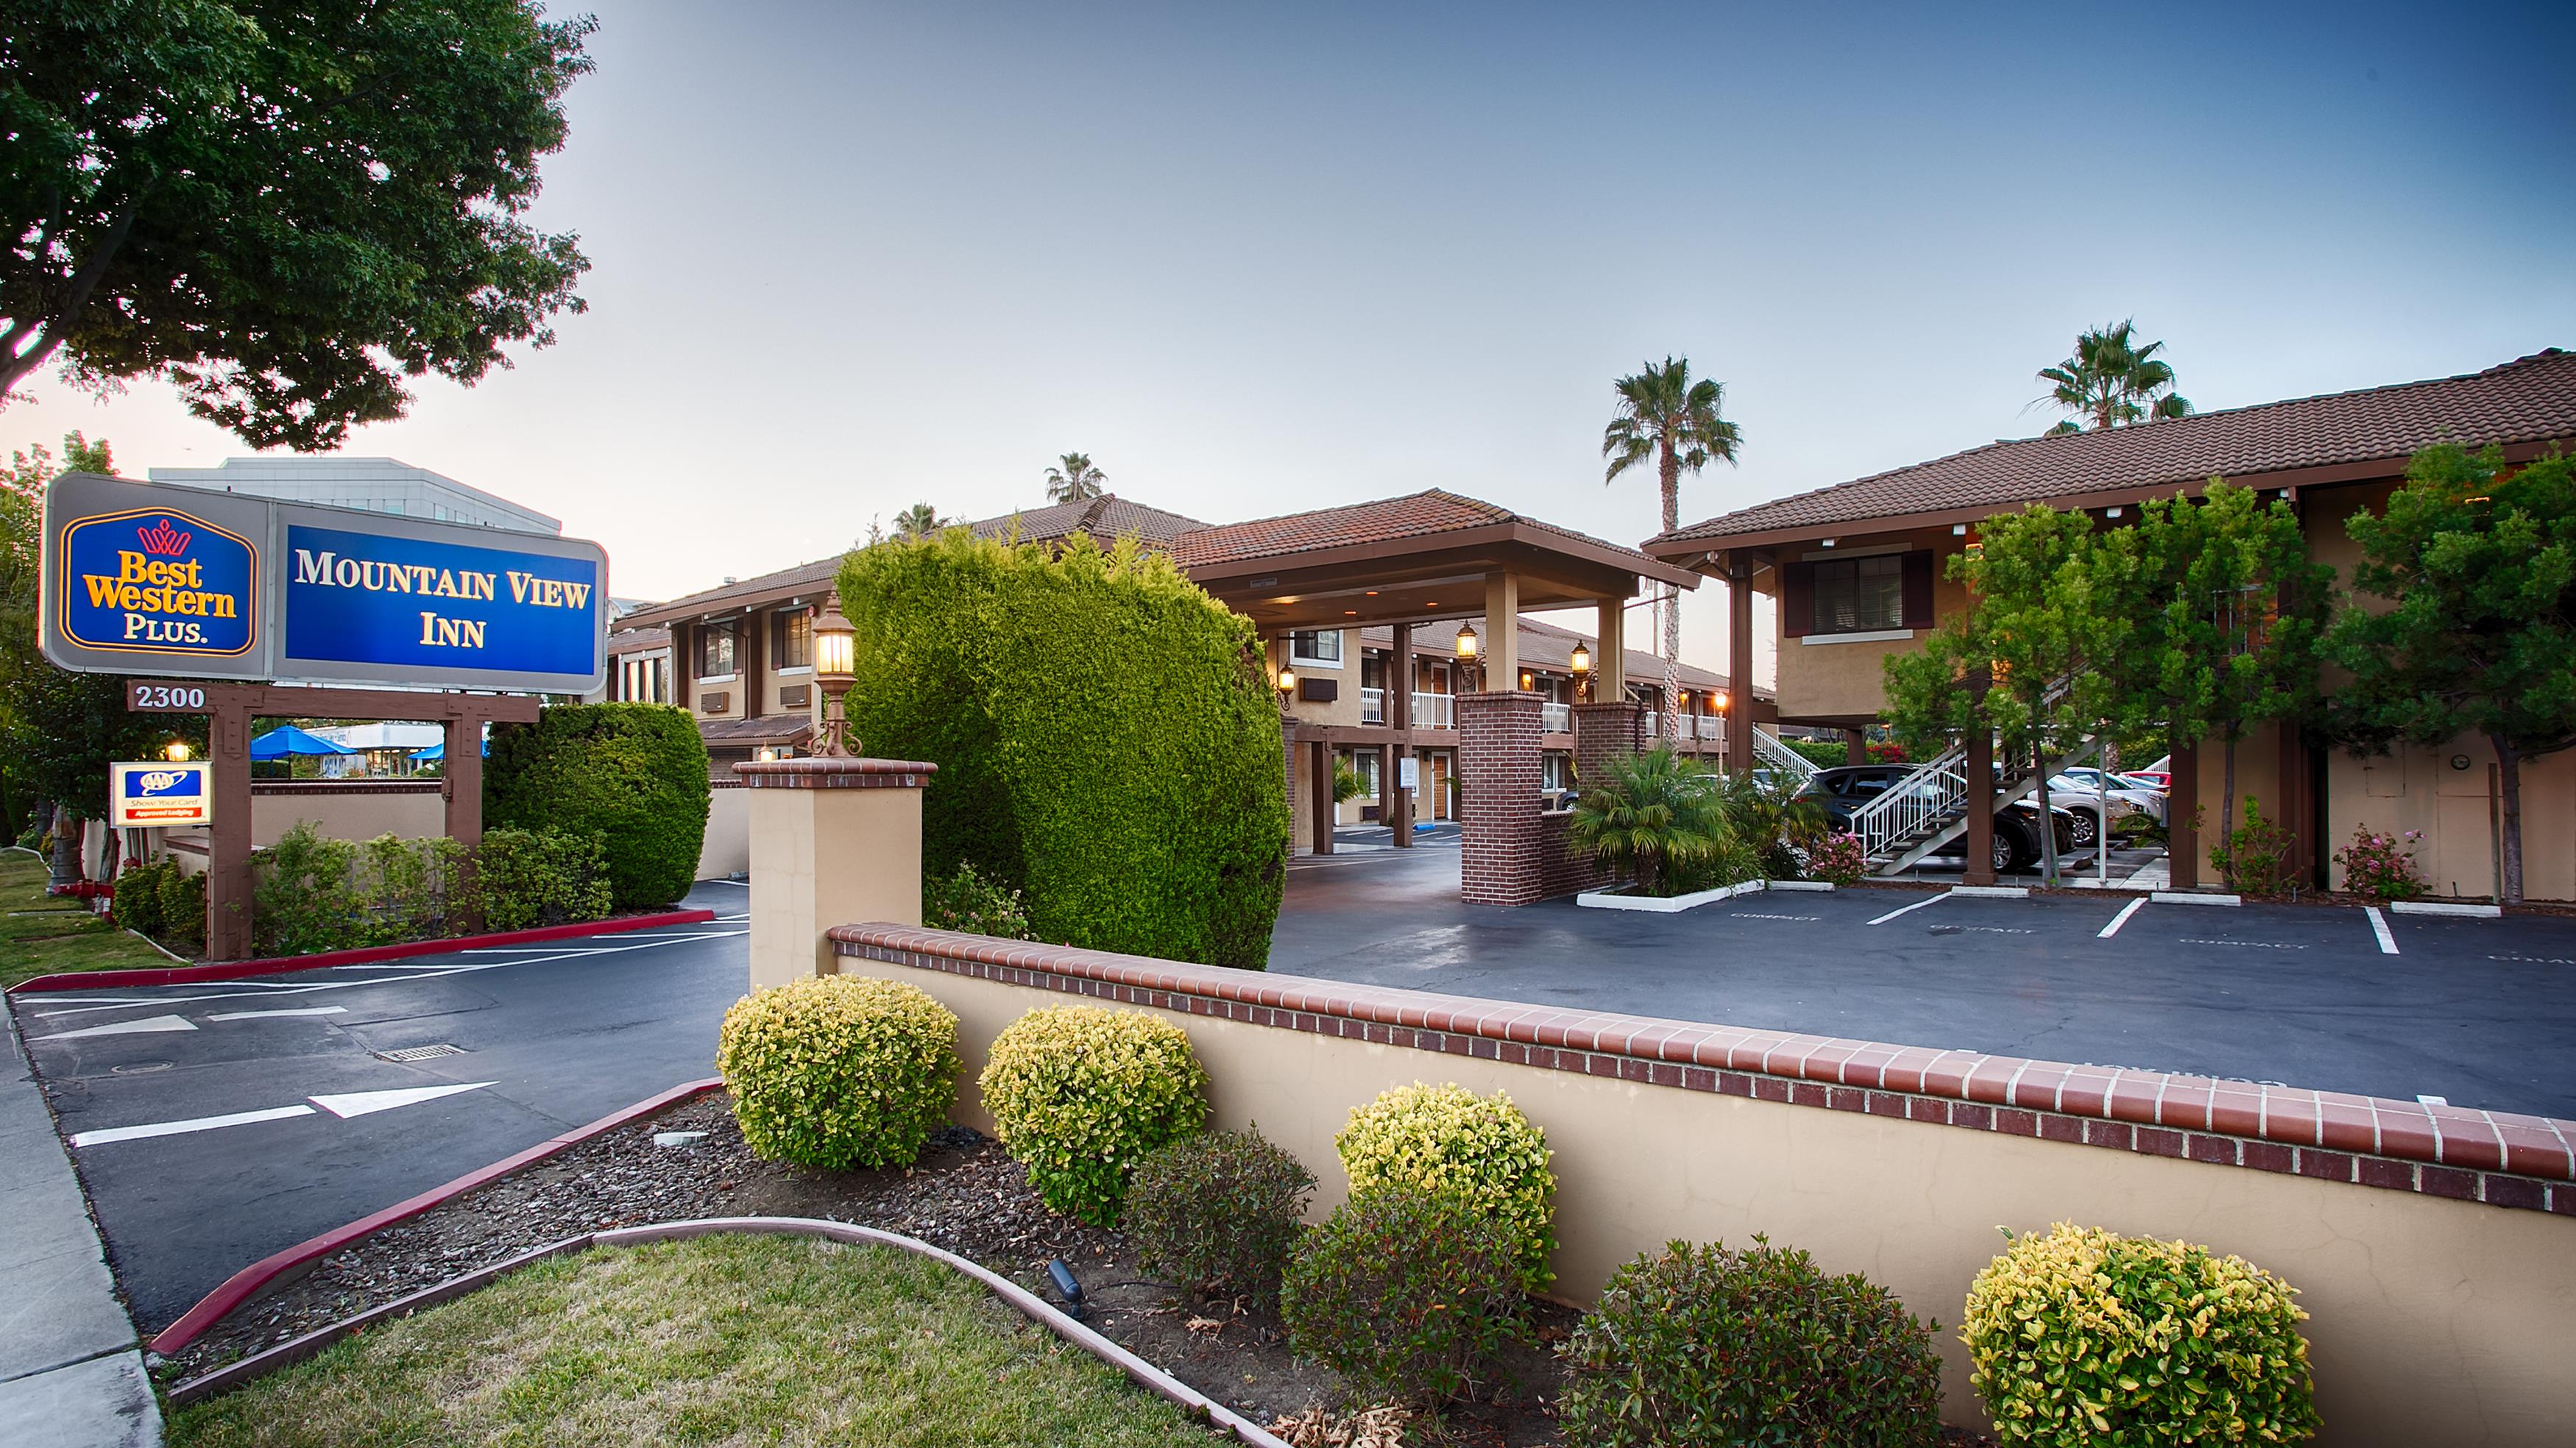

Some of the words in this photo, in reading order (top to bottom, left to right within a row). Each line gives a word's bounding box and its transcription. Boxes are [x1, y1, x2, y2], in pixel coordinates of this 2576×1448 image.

[118, 550, 203, 589] Best
[294, 548, 497, 601] MOUNTAIN
[506, 570, 591, 610] VIEW
[82, 574, 237, 618] Western
[419, 611, 487, 649] INN
[135, 686, 205, 709] 2300
